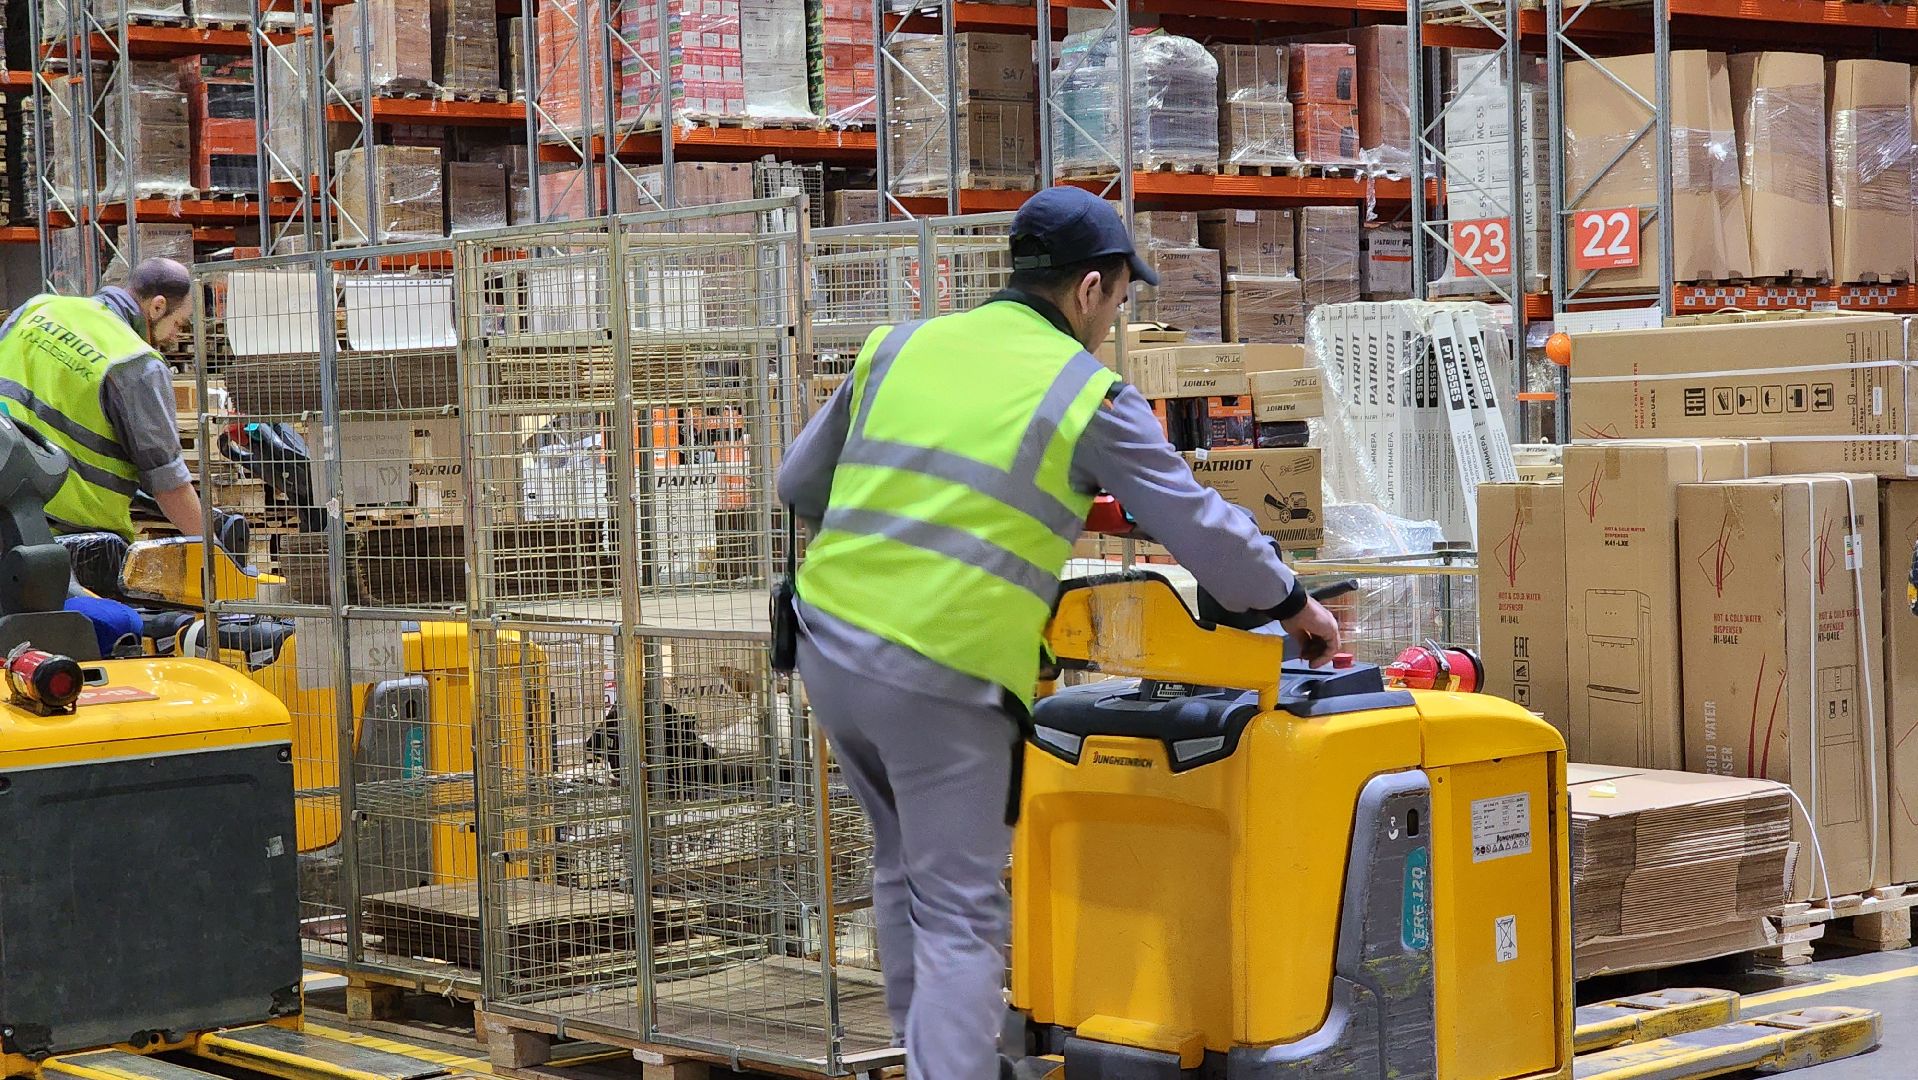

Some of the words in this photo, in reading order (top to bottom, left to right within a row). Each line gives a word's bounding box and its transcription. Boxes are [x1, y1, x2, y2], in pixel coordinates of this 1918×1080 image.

[1003, 68, 1016, 80] SA
[1477, 106, 1484, 119] 55
[1477, 122, 1484, 138] MC
[1478, 150, 1484, 164] 55
[1478, 166, 1484, 182] MC
[1525, 192, 1532, 204] 55
[1525, 208, 1532, 224] MC
[1582, 212, 1630, 256] 22
[1460, 223, 1506, 264] 23
[1526, 254, 1532, 270] MC
[1272, 314, 1286, 325] SA
[1288, 314, 1294, 325] 7
[28, 315, 108, 363] PATRIOT
[1442, 345, 1452, 361] PT
[1472, 344, 1481, 358] PT
[1352, 332, 1360, 405] PATRIOT
[1368, 332, 1378, 405] PATRIOT
[1446, 362, 1461, 402] 3555ES
[1476, 359, 1492, 400] 3555ES
[1686, 389, 1705, 415] EAC
[1193, 460, 1253, 472] PATRIOT
[1480, 435, 1496, 481] ТРИММЕРА
[658, 473, 716, 488] PATRIO
[1730, 614, 1743, 622] COLD
[1819, 611, 1827, 620] HOT
[1714, 625, 1742, 634] DISPENSER
[1514, 636, 1529, 657] EAC
[1705, 701, 1716, 740] WATER
[1093, 751, 1152, 768] JUNGHEINRICH
[1497, 832, 1529, 842] JUNGHEINRICH
[1413, 904, 1425, 940] ERE
